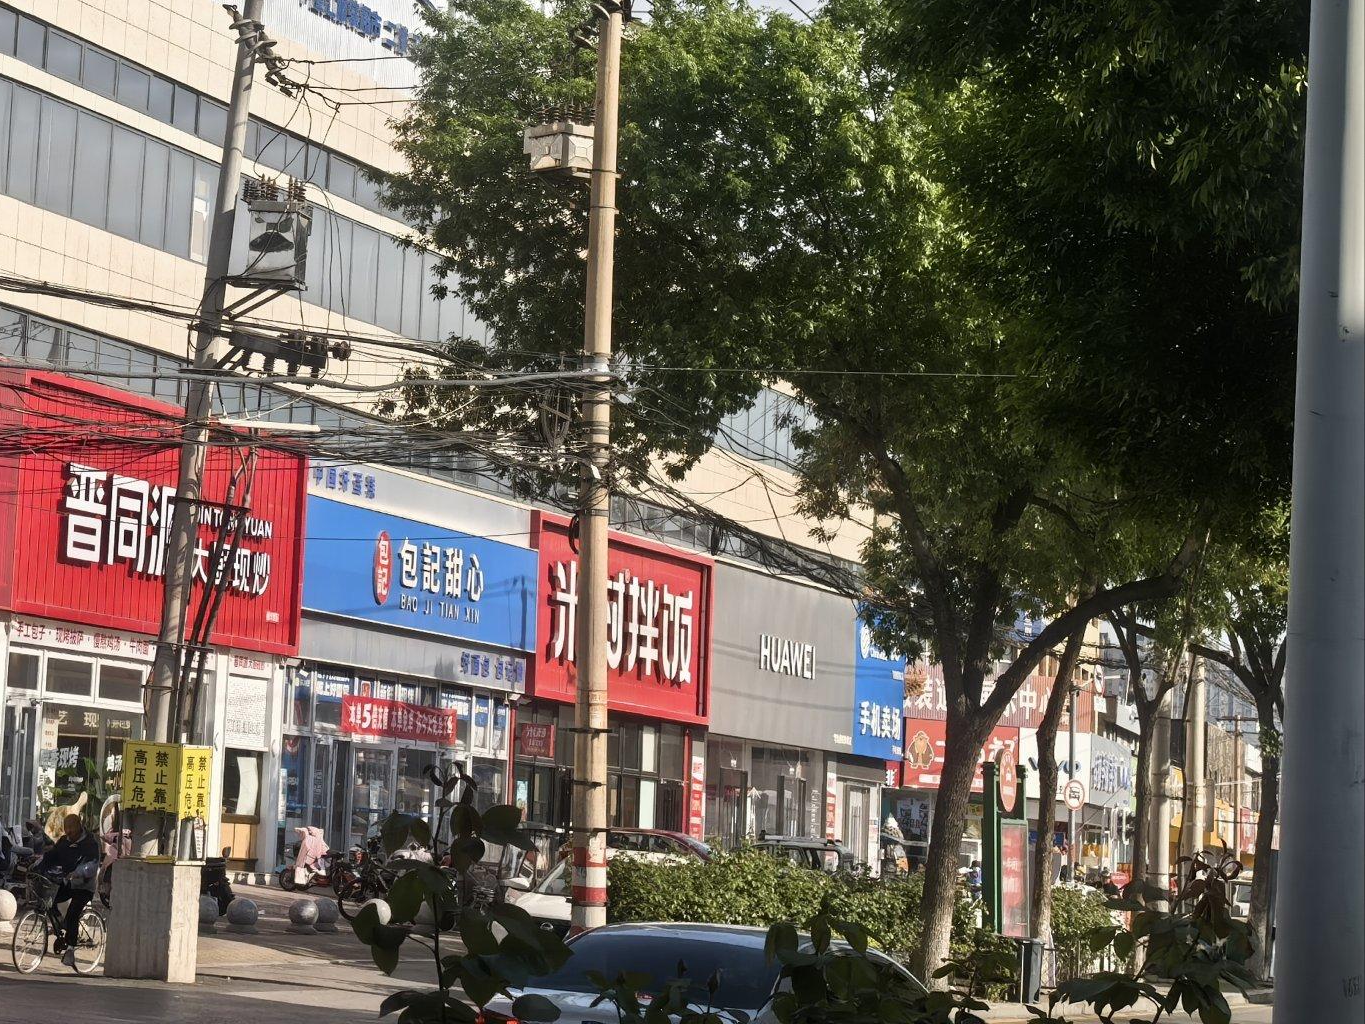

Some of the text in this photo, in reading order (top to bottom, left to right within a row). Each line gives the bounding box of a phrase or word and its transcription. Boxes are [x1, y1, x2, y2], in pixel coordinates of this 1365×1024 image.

[245, 517, 272, 539] YUAN
[400, 594, 480, 624] BAO JI TIAN XIN
[760, 634, 816, 680] HUAWEI
[859, 701, 901, 741] 手机卖场
[196, 756, 207, 815] 禁止靠
